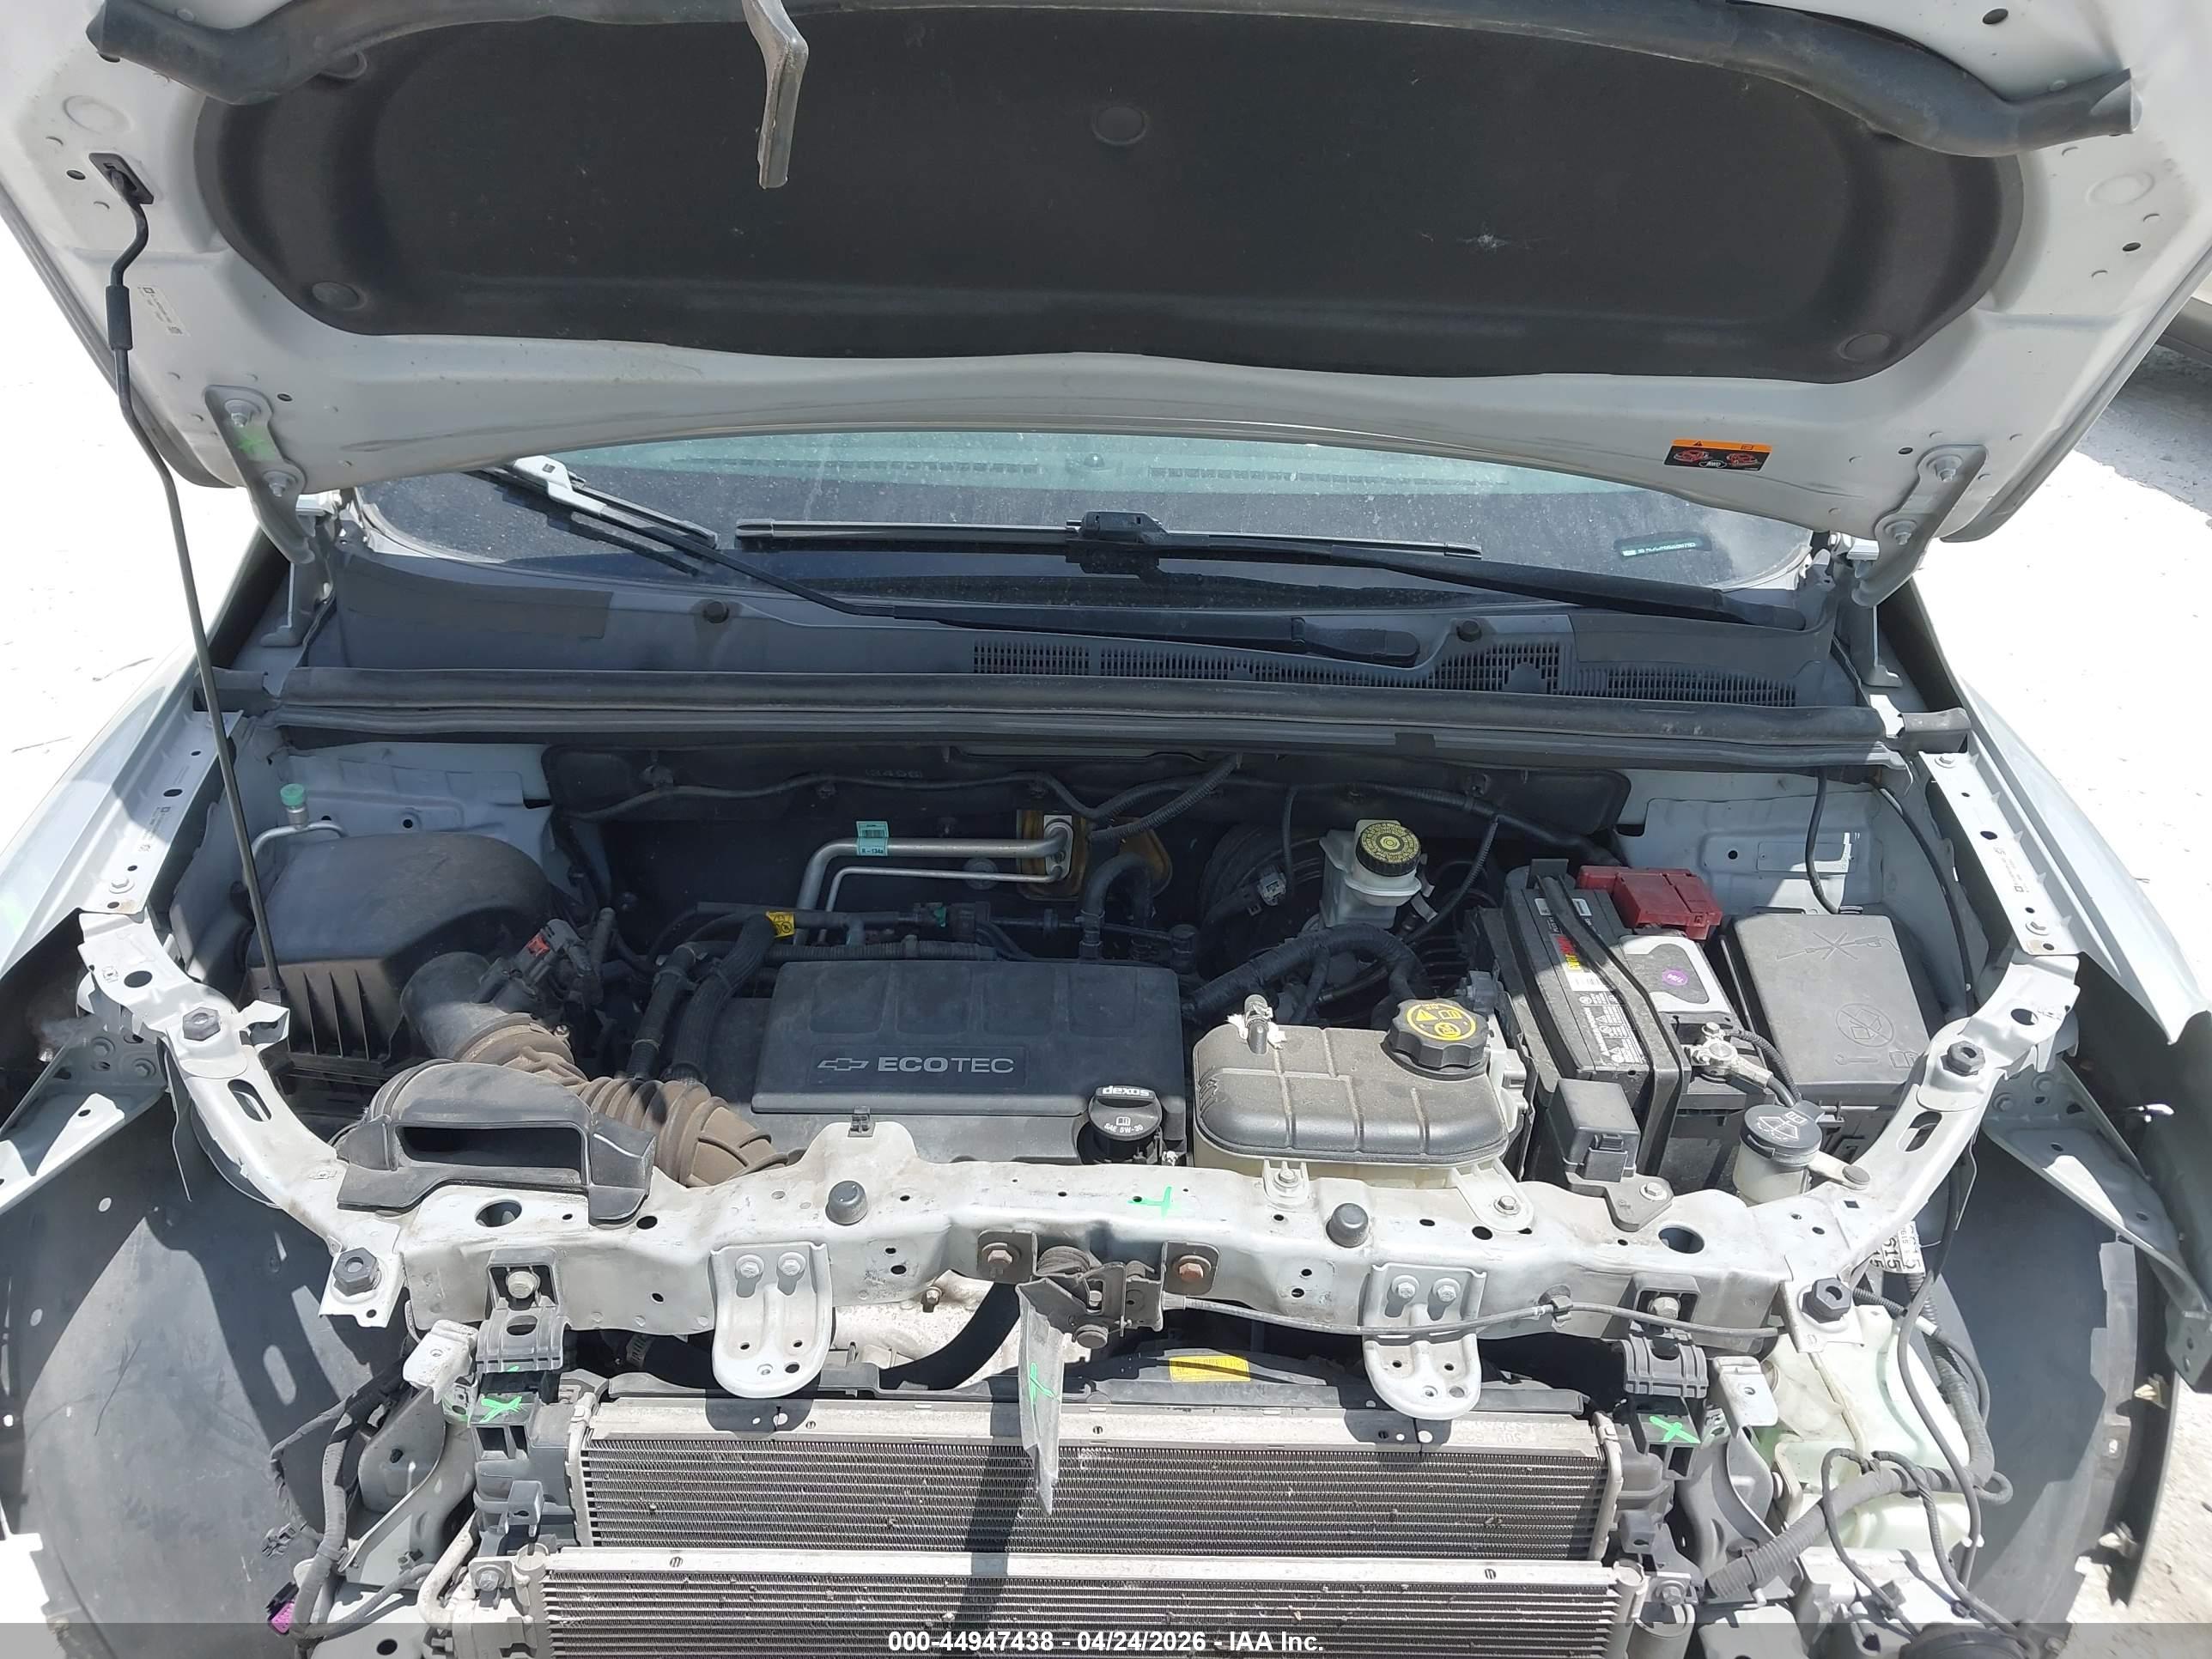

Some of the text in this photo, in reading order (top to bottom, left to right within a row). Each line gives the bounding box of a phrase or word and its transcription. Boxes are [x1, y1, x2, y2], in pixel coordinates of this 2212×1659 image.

[878, 1056, 1014, 1073] ECOTEC
[1102, 1085, 1150, 1097] dexos
[1104, 1122, 1144, 1133] SAE 5W-30
